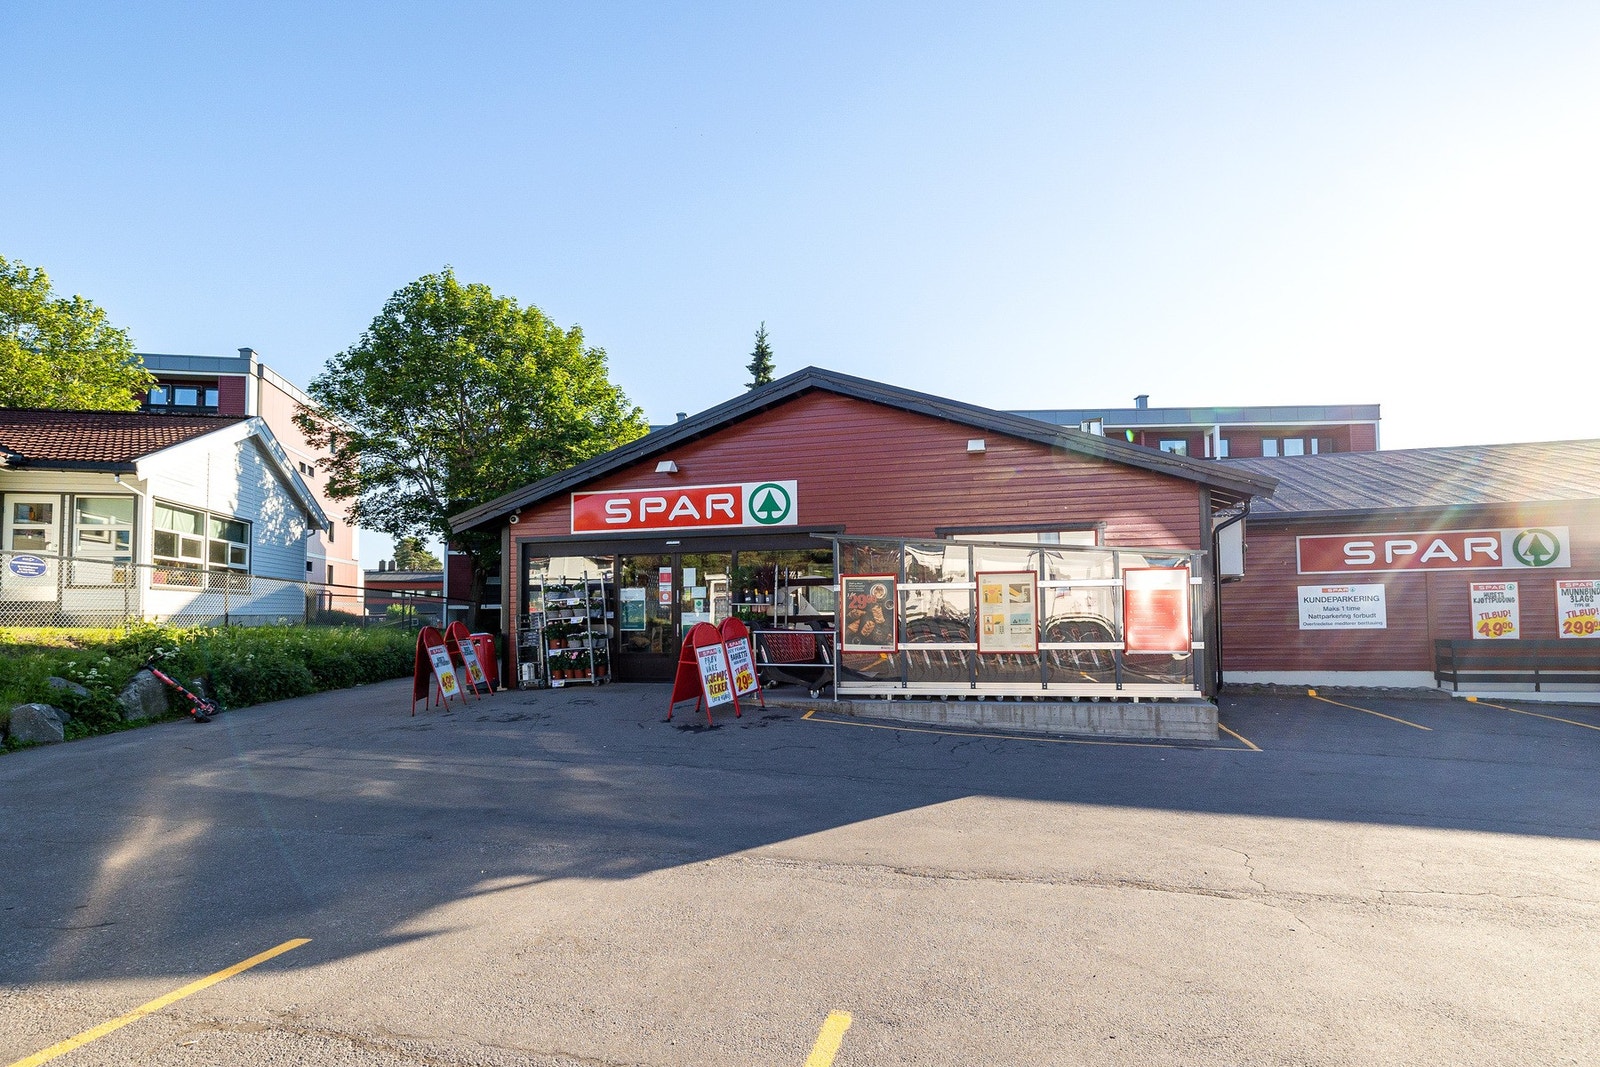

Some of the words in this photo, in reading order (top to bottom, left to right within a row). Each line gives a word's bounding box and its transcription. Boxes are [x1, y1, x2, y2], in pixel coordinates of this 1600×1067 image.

[605, 493, 735, 524] SPAR
[1343, 537, 1499, 565] SPAR
[1303, 595, 1380, 604] KUNDEPARKERING
[1479, 610, 1512, 620] TILBUD!
[1565, 608, 1599, 618] TILBUD!
[702, 648, 717, 656] SPAR
[704, 670, 728, 685] KJEMPE
[709, 682, 729, 696] REKER
